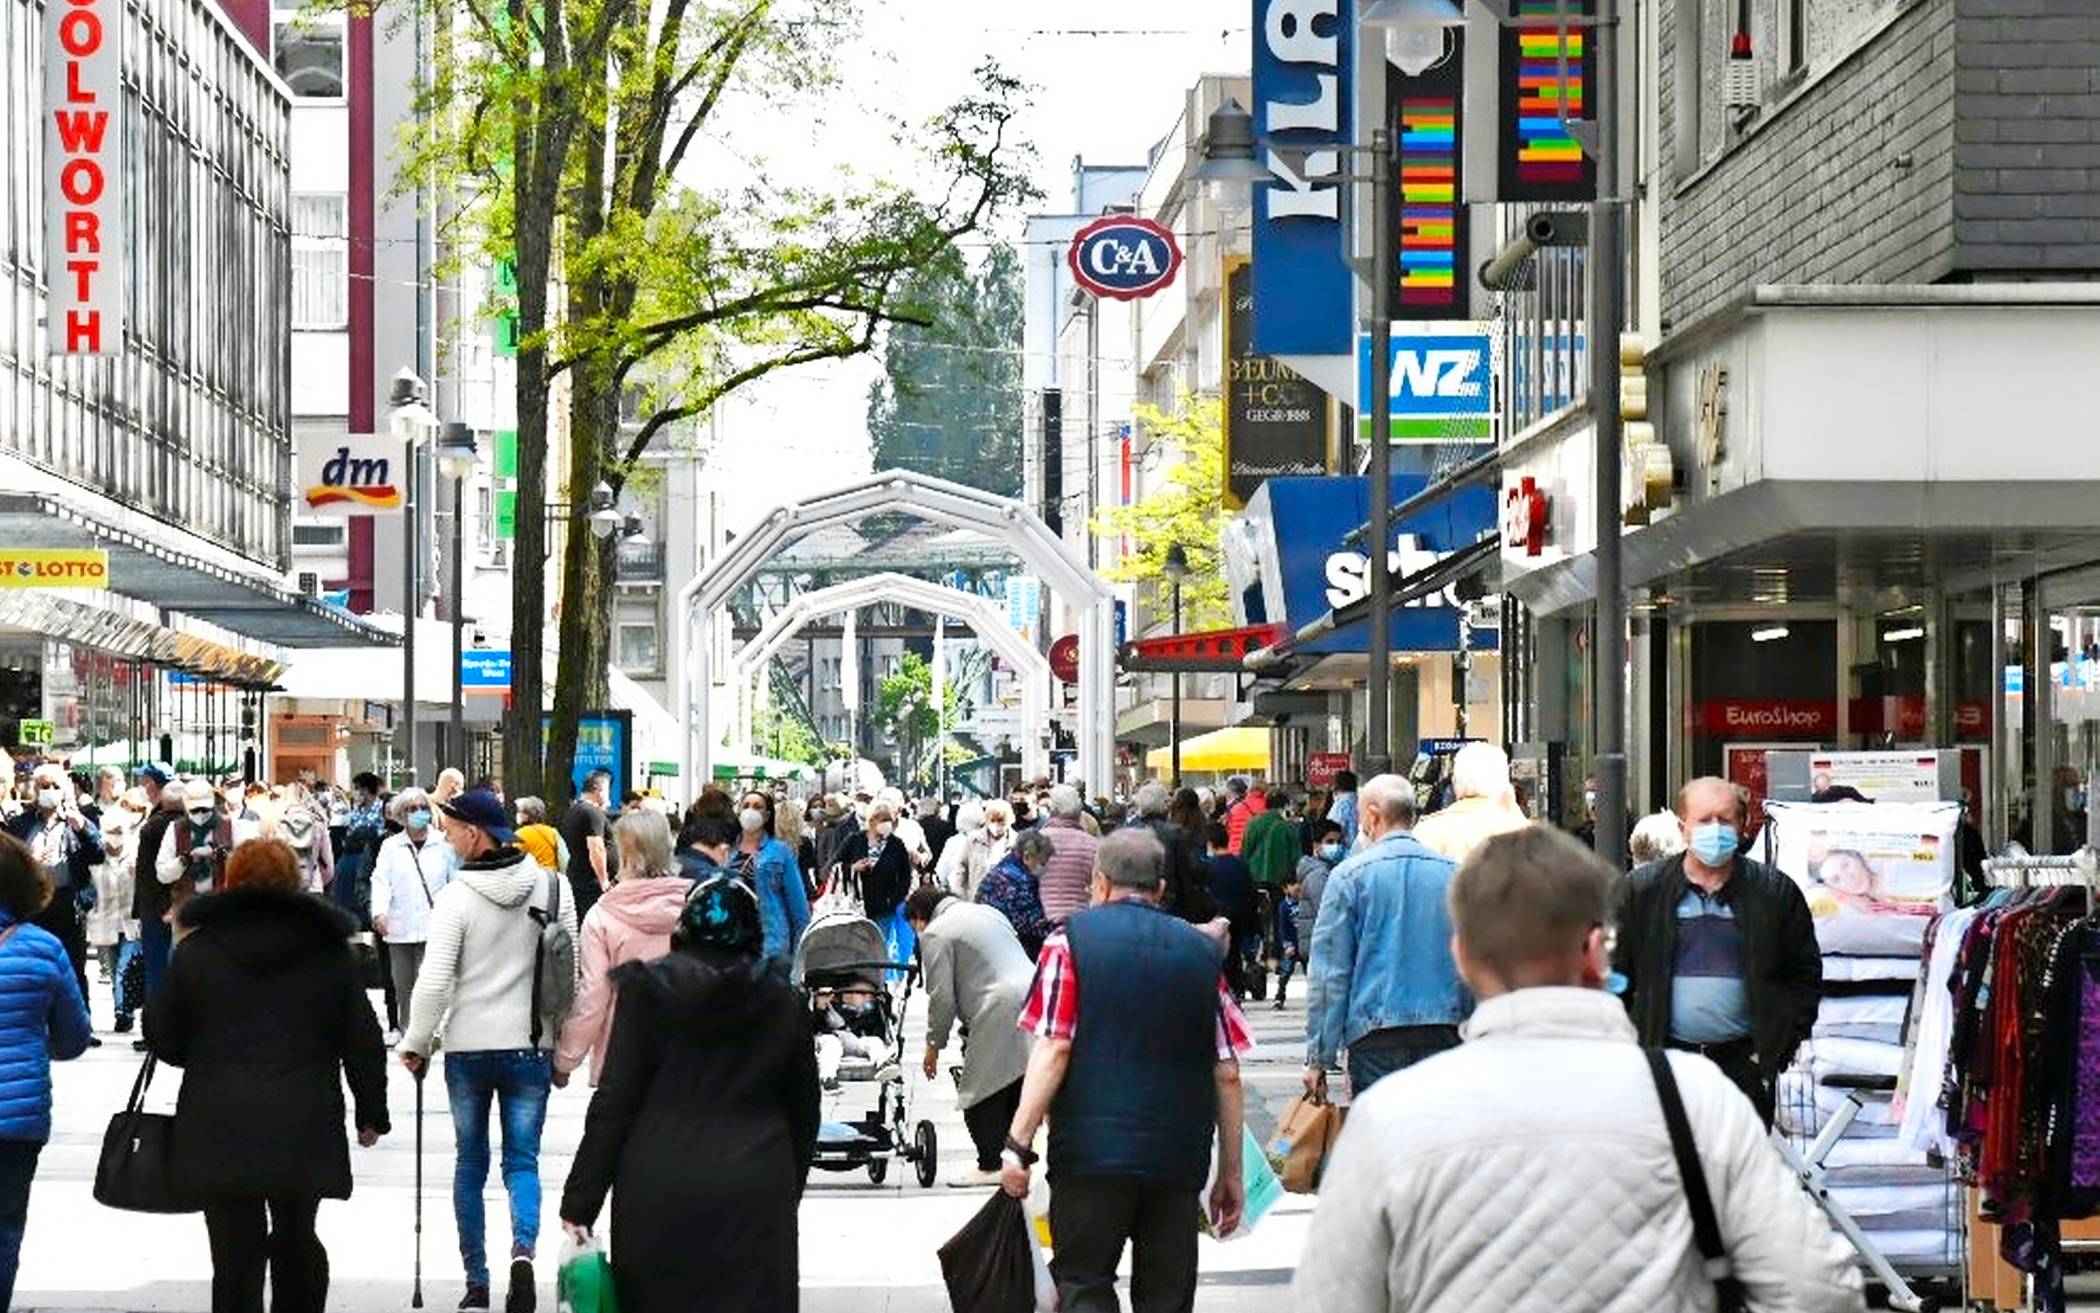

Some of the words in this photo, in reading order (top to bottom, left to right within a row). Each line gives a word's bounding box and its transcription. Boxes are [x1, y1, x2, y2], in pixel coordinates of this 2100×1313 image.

[54, 0, 108, 353] OLWORTH
[1091, 239, 1160, 275] C&A
[322, 447, 388, 485] dm
[36, 561, 104, 576] LOTTO
